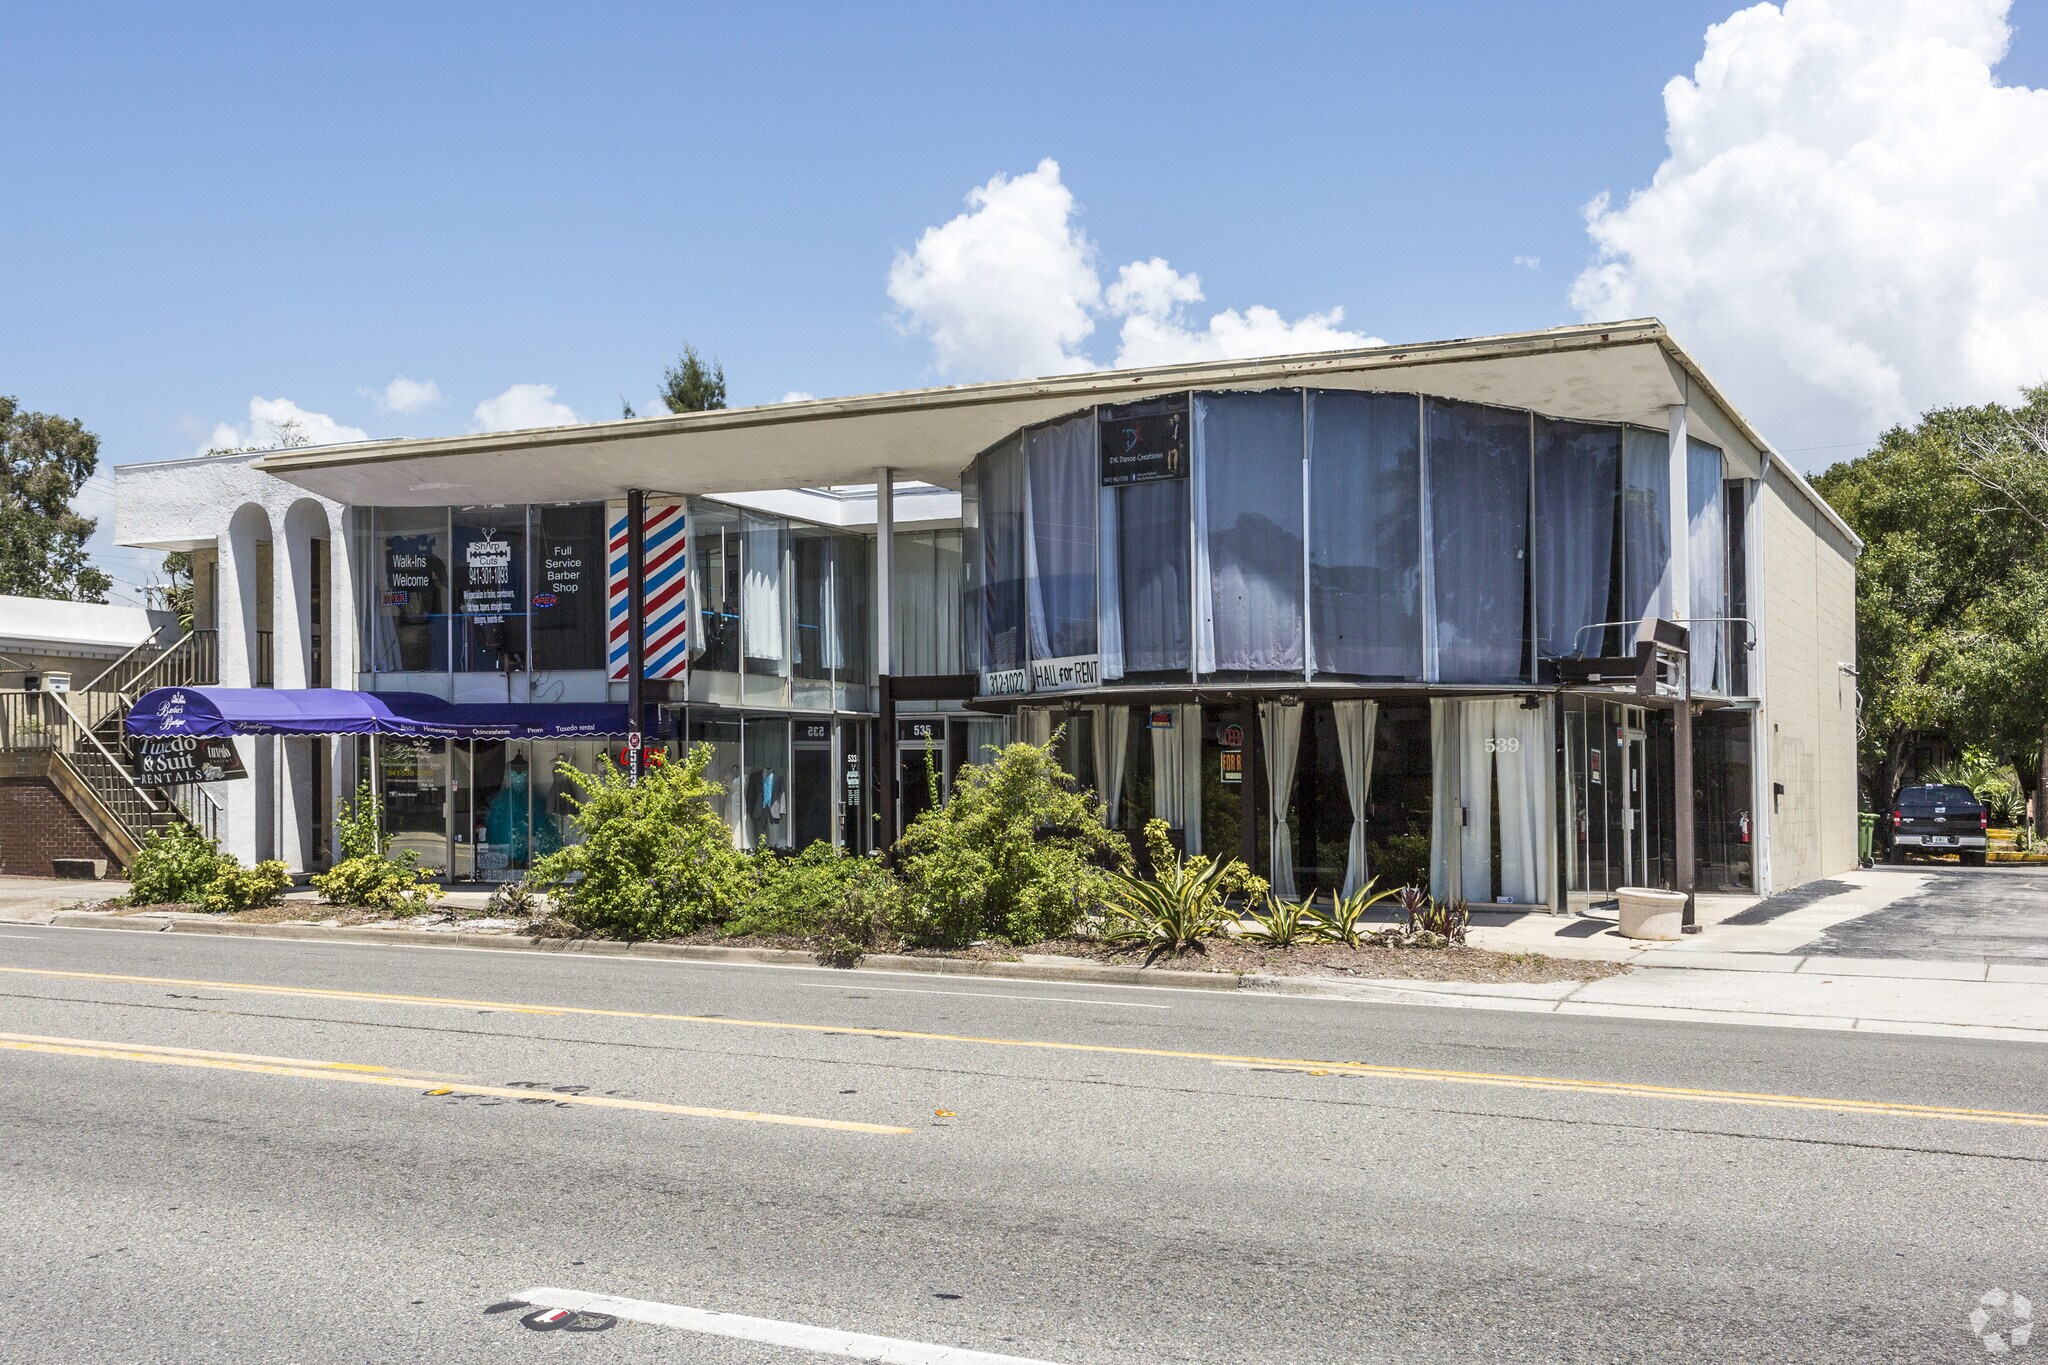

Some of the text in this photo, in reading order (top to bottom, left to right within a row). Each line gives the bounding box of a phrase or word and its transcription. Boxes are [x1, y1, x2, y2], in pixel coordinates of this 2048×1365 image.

[1109, 453, 1164, 464] DK Dance Creations
[554, 546, 572, 556] Full
[392, 554, 427, 568] Walk-Ins
[480, 557, 498, 565] Cuts
[545, 558, 582, 569] Service
[392, 573, 429, 587] Welcome
[547, 571, 580, 581] Barber
[552, 582, 579, 593] Shop
[532, 596, 557, 605] OPEN
[1034, 661, 1099, 687] HALL for RENT
[989, 672, 1025, 695] 312-1022
[235, 721, 273, 732] Boutique
[400, 724, 416, 732] Bridal
[423, 726, 458, 735] Homecoming
[555, 725, 578, 733] Tuxedo
[579, 724, 595, 732] rental
[913, 725, 931, 736] 535
[140, 737, 197, 755] Tuxedo
[1484, 737, 1520, 753] 539
[143, 752, 196, 772] & Suit
[847, 754, 858, 763] 533
[1223, 754, 1235, 771] FOR
[141, 769, 203, 785] RENTALS
